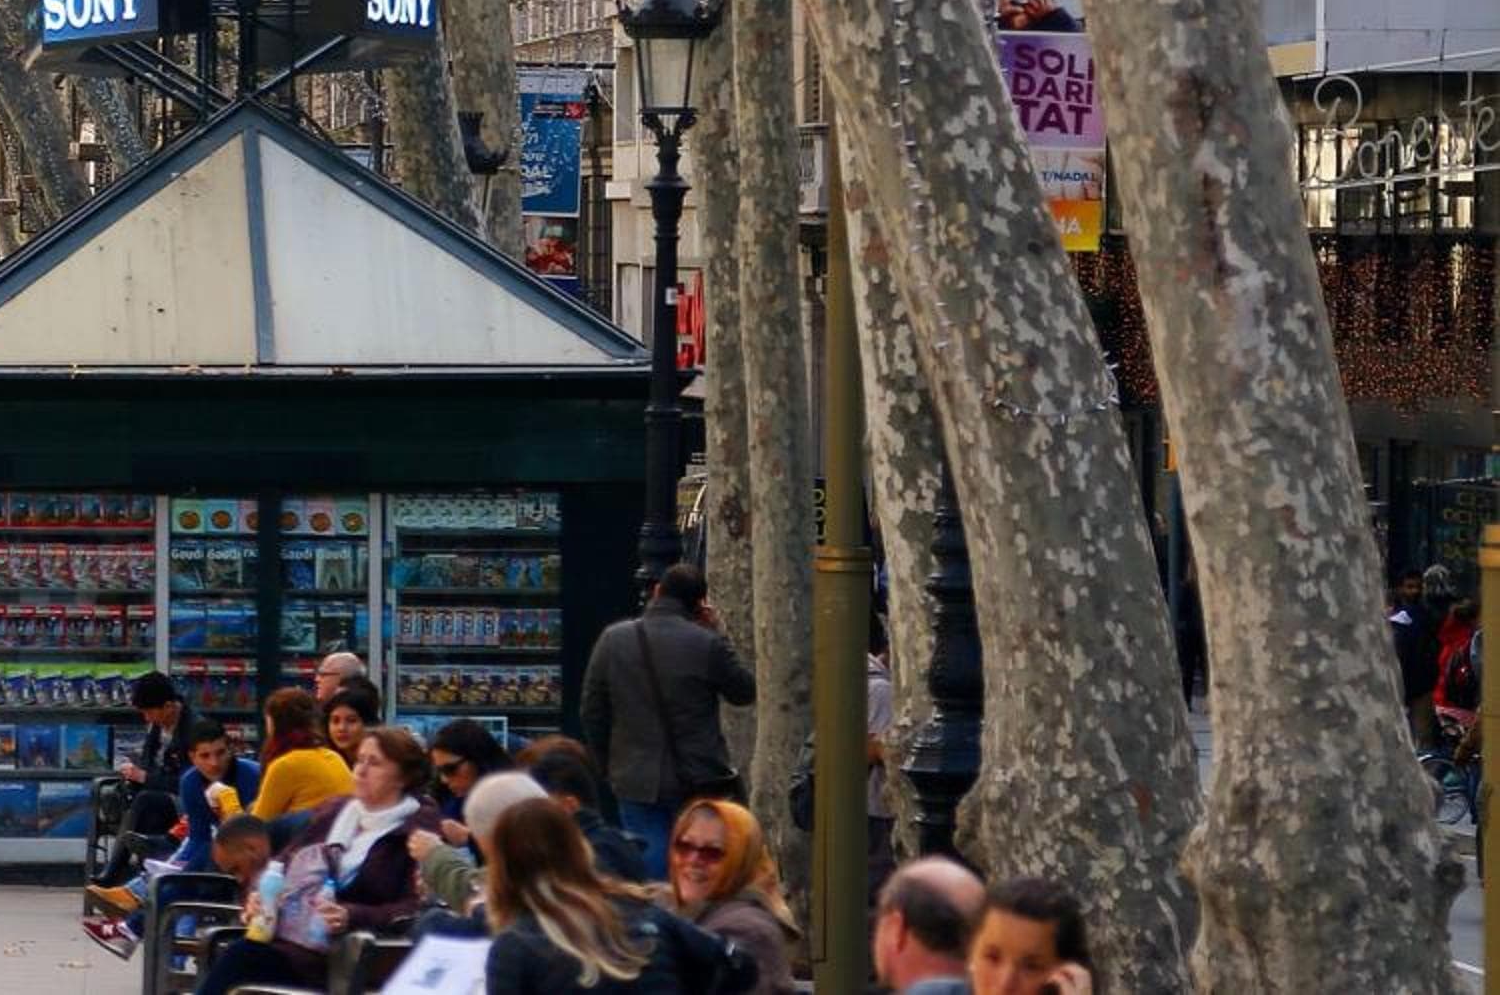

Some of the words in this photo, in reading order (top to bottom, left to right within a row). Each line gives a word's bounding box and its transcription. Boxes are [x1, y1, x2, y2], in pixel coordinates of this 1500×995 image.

[1012, 43, 1096, 83] SOLI
[1011, 72, 1095, 106] DARI
[1013, 97, 1092, 136] TAT
